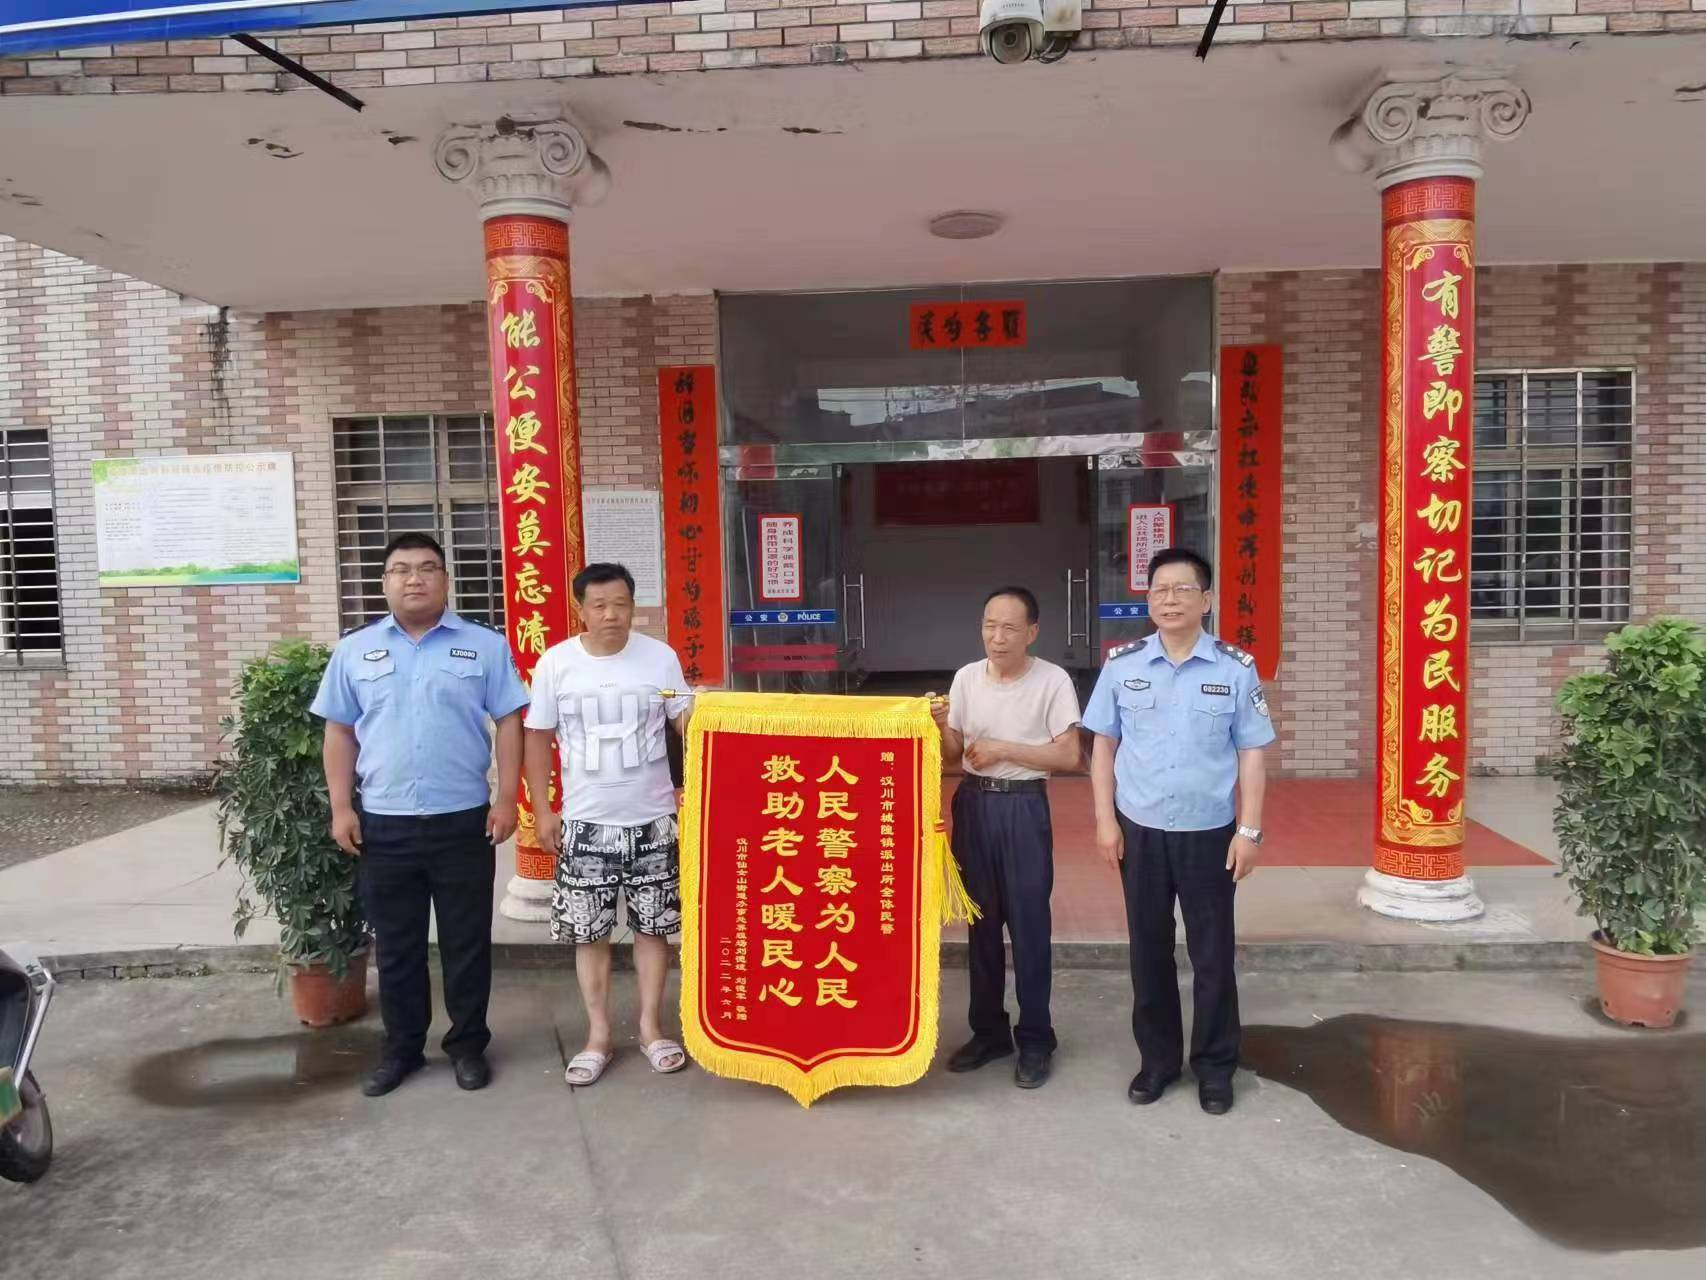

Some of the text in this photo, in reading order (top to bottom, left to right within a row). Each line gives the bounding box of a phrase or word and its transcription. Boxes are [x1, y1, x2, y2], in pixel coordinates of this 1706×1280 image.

[1414, 270, 1467, 798] 有警即察切记为民服务
[744, 613, 769, 623] 公安
[797, 612, 821, 621] POLICE
[1113, 606, 1140, 616] 公安
[759, 756, 804, 1007] 救助老人暖民心
[815, 756, 858, 1008] 人民警察为人民
